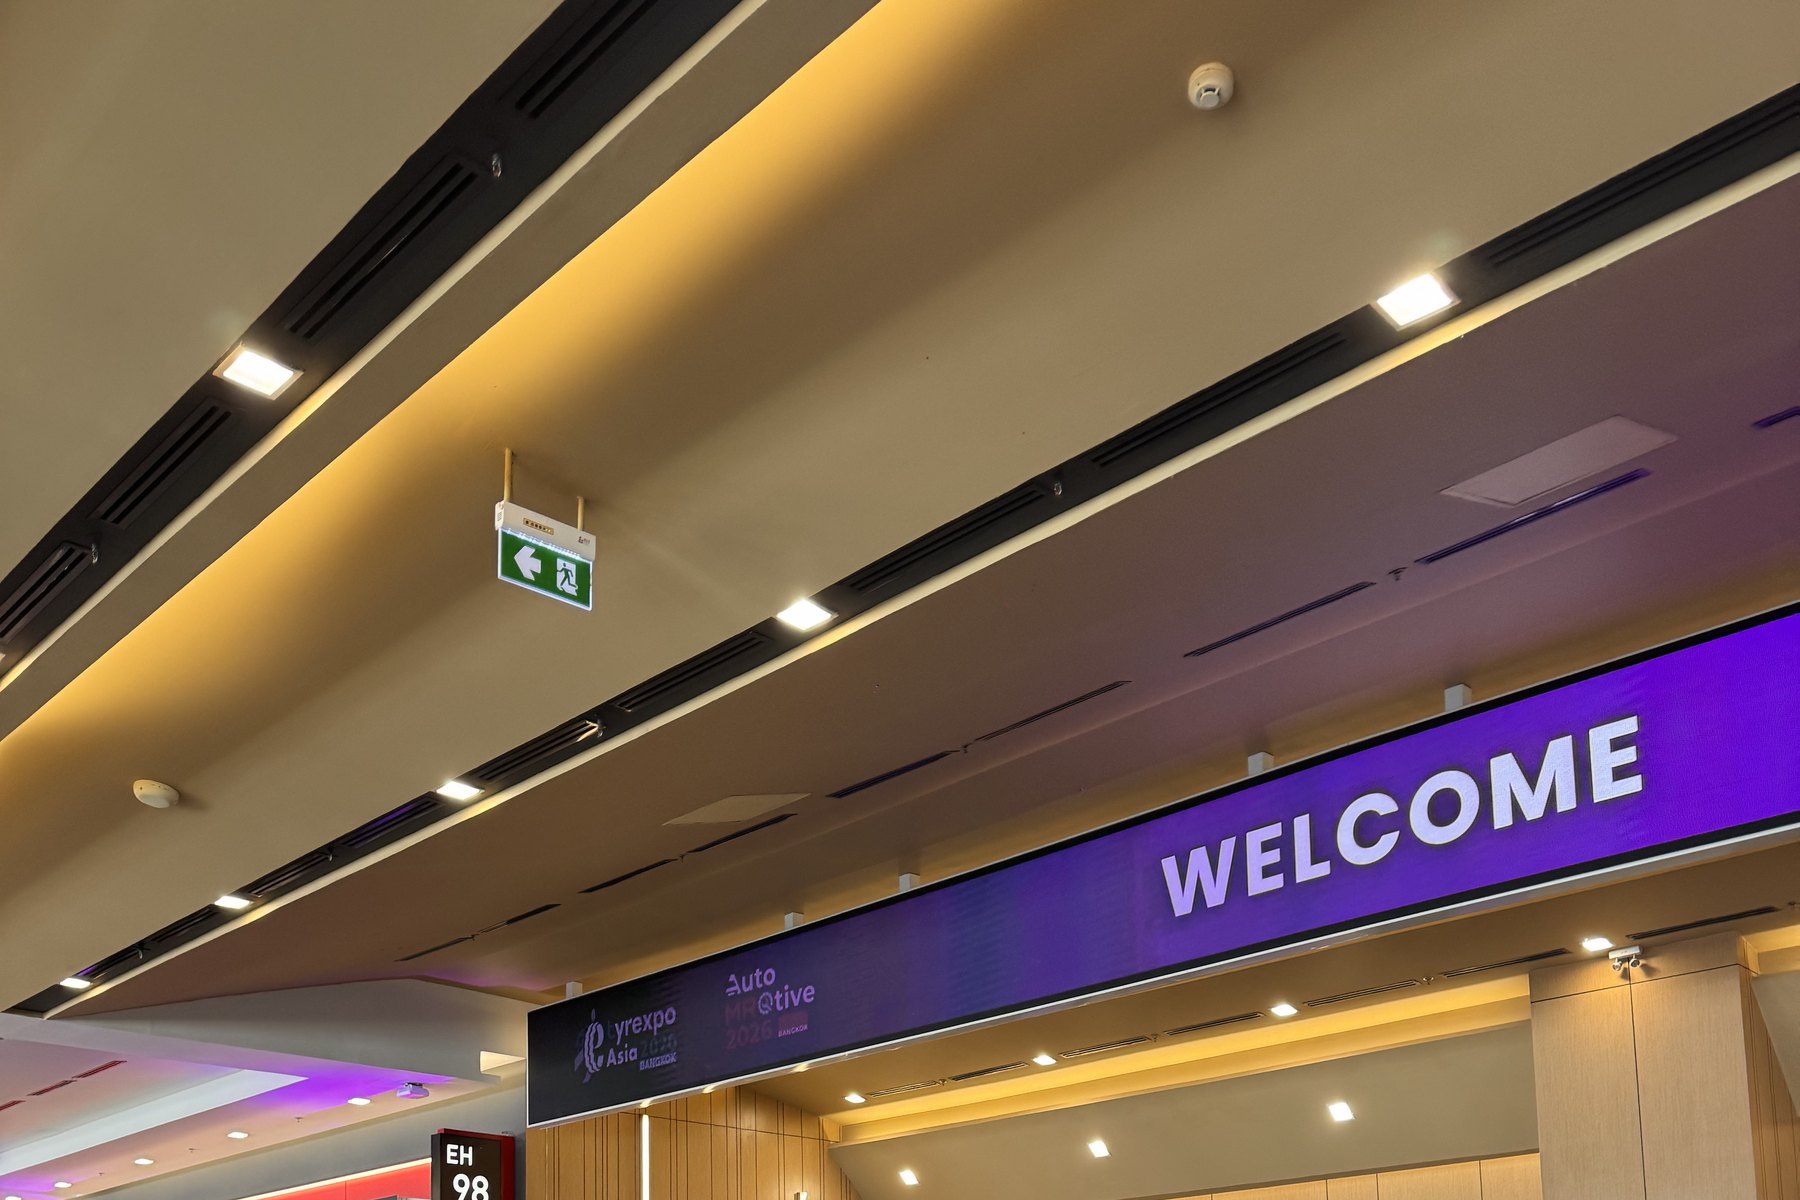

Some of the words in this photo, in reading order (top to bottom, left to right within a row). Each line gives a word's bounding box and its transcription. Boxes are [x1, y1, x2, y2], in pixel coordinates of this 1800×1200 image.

[1161, 715, 1643, 917] WELCOME
[725, 967, 776, 997] Auto
[606, 1043, 638, 1068] Asia
[639, 1052, 677, 1071] BANGKOK
[446, 1143, 473, 1166] EH
